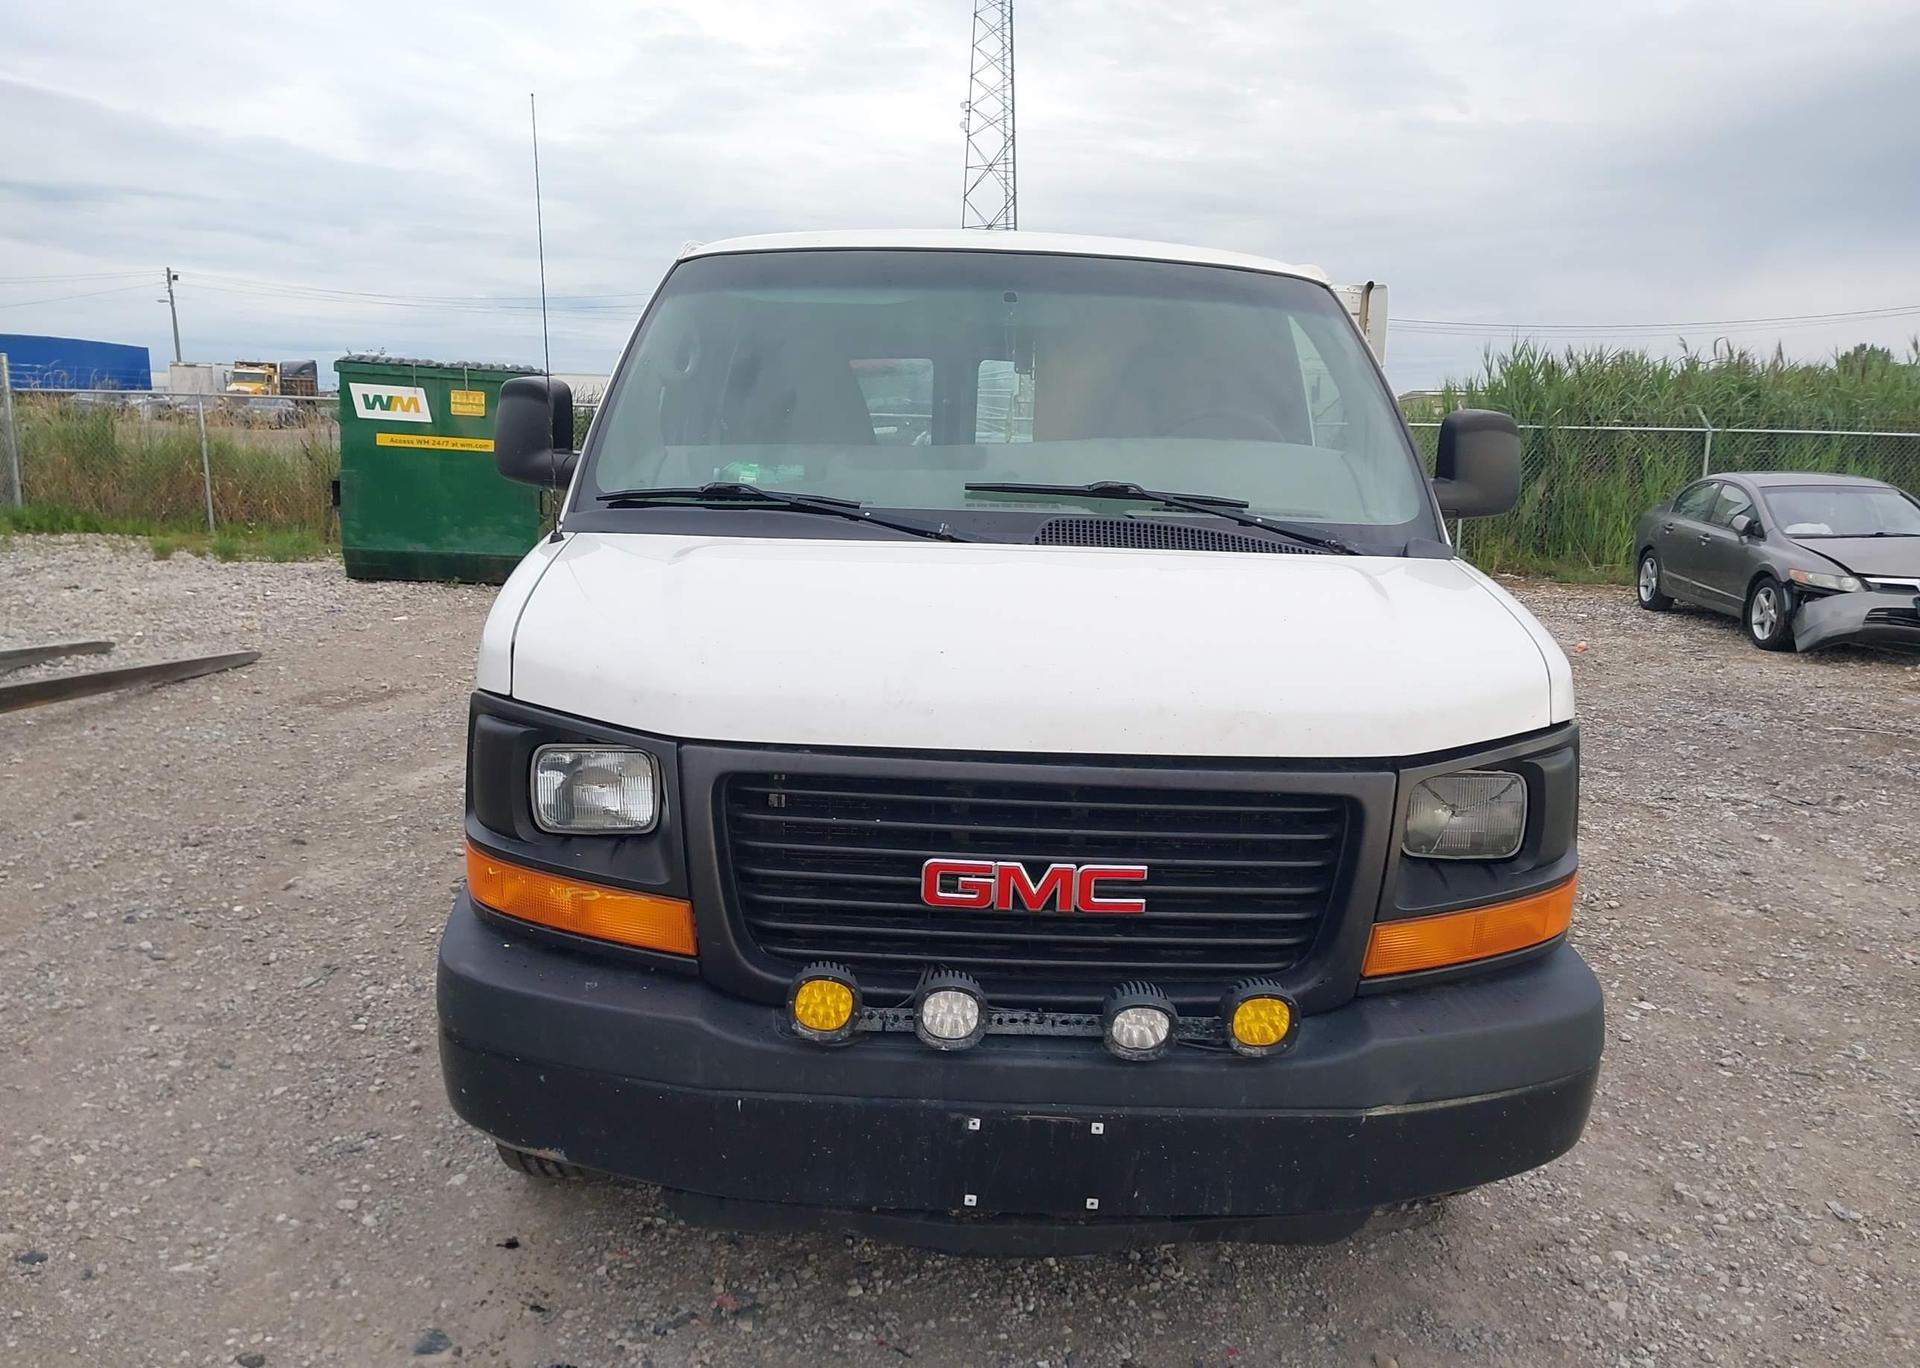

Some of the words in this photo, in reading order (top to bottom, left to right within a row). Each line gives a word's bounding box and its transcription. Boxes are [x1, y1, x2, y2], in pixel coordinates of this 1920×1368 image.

[362, 393, 421, 413] WM
[389, 437, 414, 445] Access
[415, 438, 430, 446] WM
[460, 442, 490, 450] wm.com
[921, 858, 1148, 913] GMC
